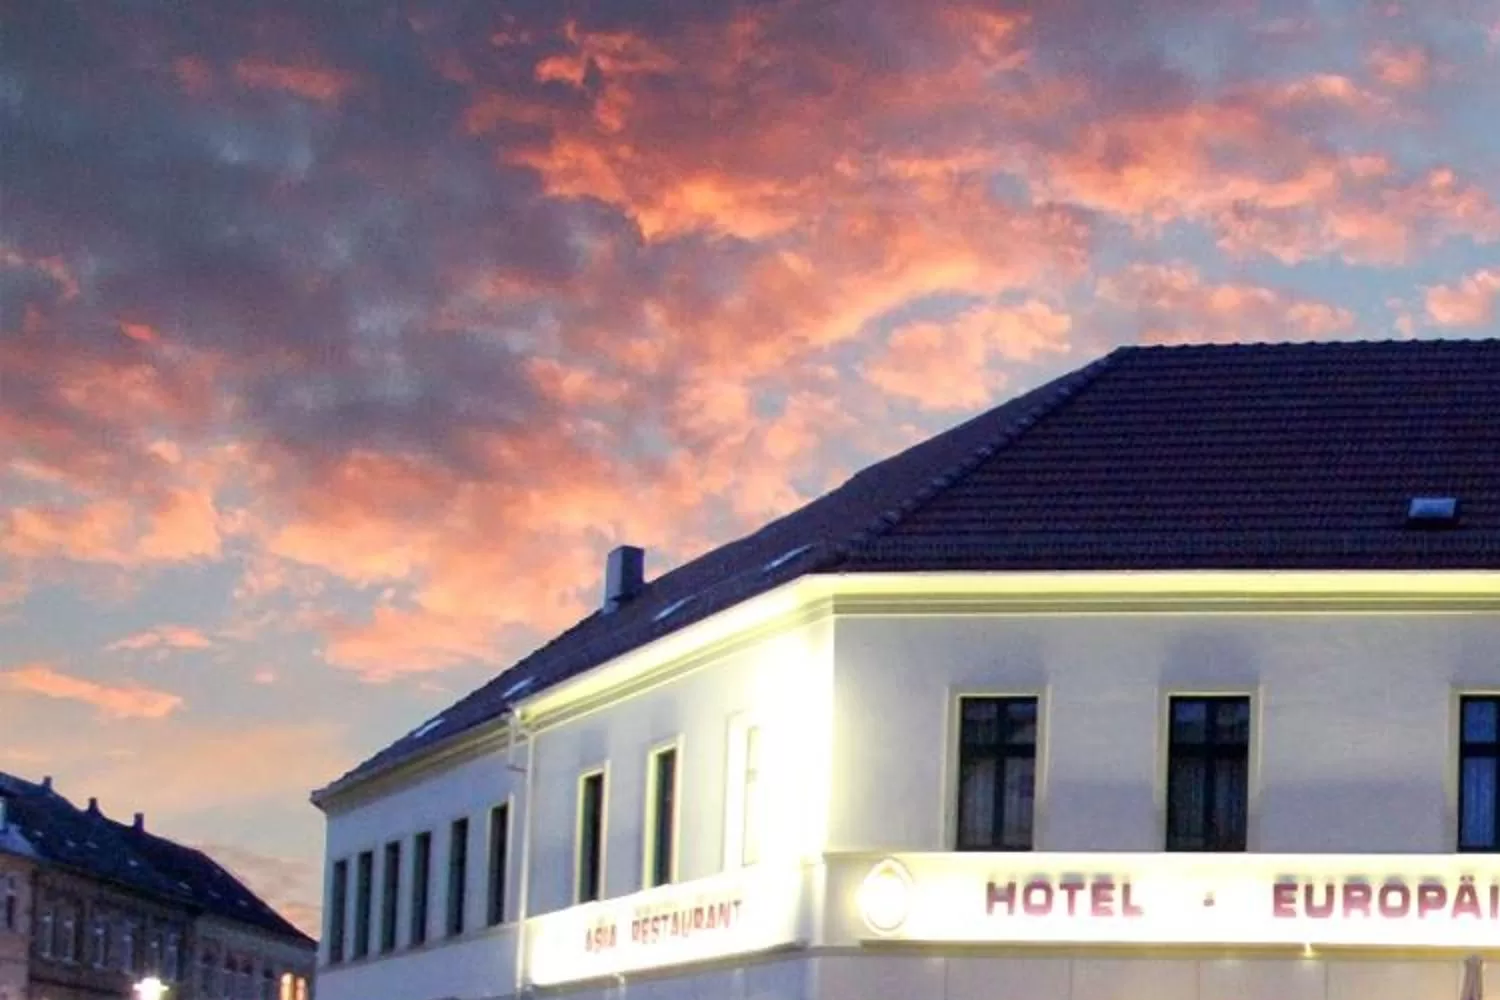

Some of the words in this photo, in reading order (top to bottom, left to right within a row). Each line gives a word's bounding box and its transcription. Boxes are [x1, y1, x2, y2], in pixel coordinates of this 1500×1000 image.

[985, 879, 1143, 916] HOTEL
[584, 923, 618, 953] ASIA
[631, 899, 742, 945] RESTAURANT
